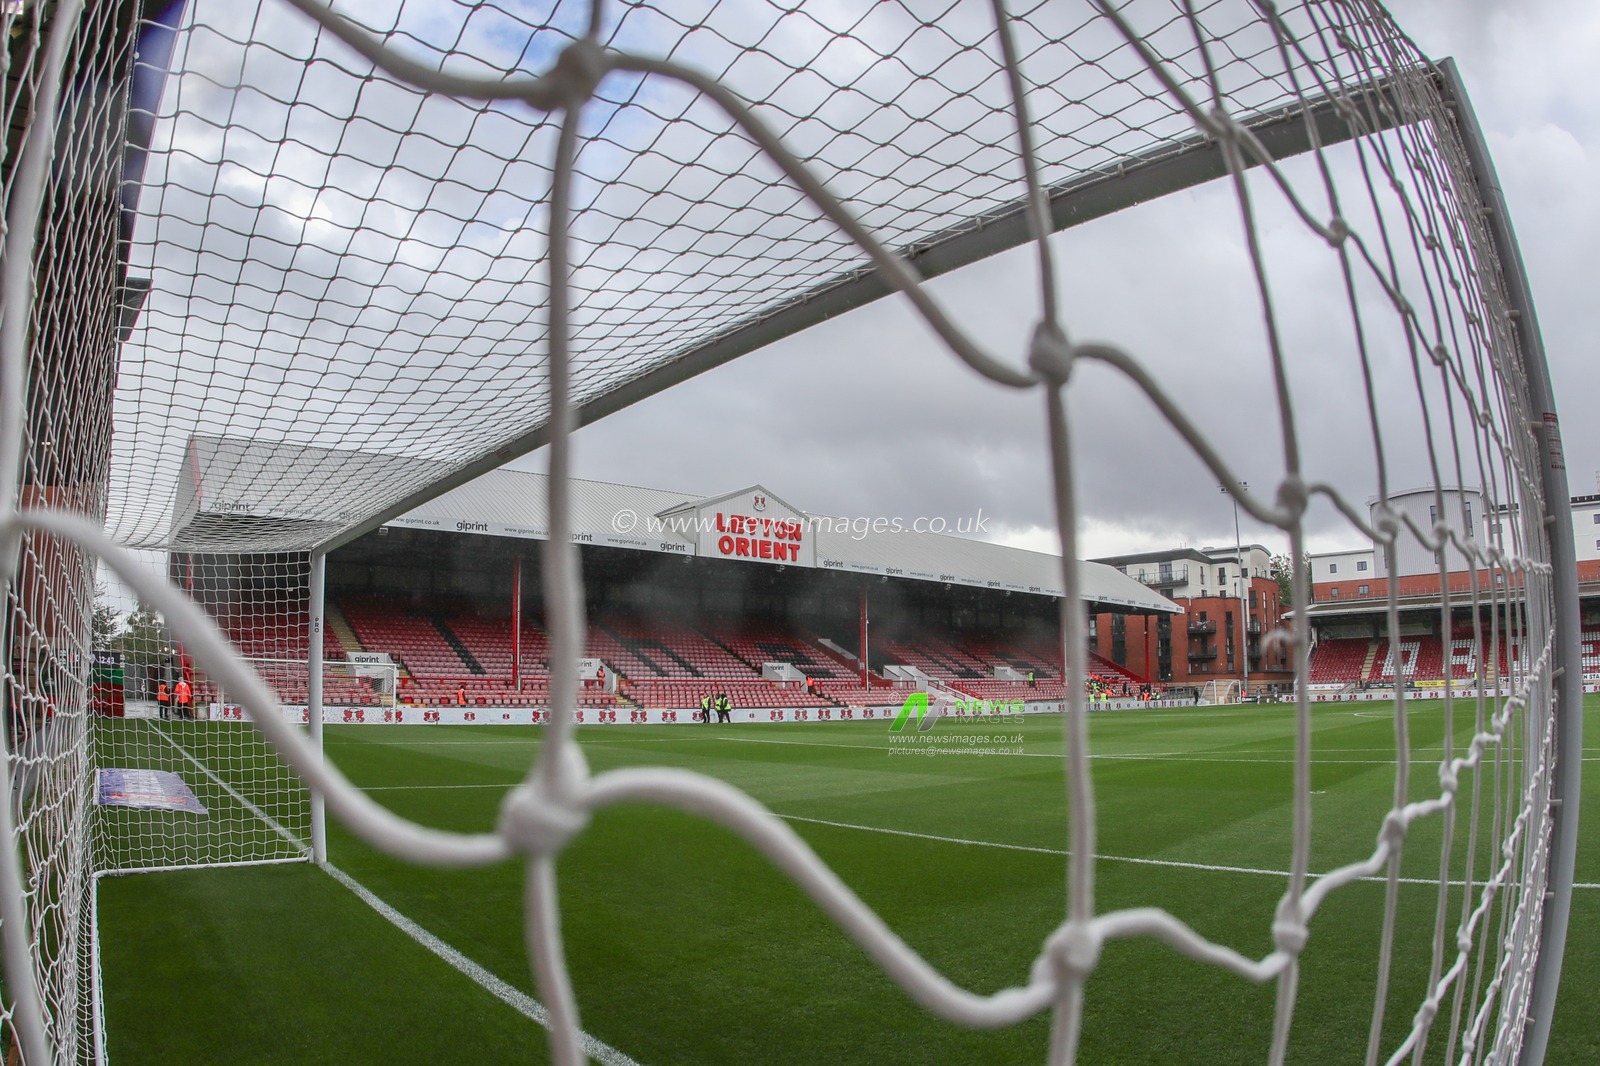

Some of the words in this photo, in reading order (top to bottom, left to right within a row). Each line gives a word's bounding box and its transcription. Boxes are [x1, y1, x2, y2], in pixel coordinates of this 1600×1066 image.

[456, 520, 488, 532] giprint
[716, 513, 802, 541] LEYTON
[660, 541, 686, 551] giprint
[718, 535, 800, 561] ORIENT
[823, 559, 844, 568] giprint
[885, 567, 903, 575] giprint
[939, 574, 955, 582] giprint
